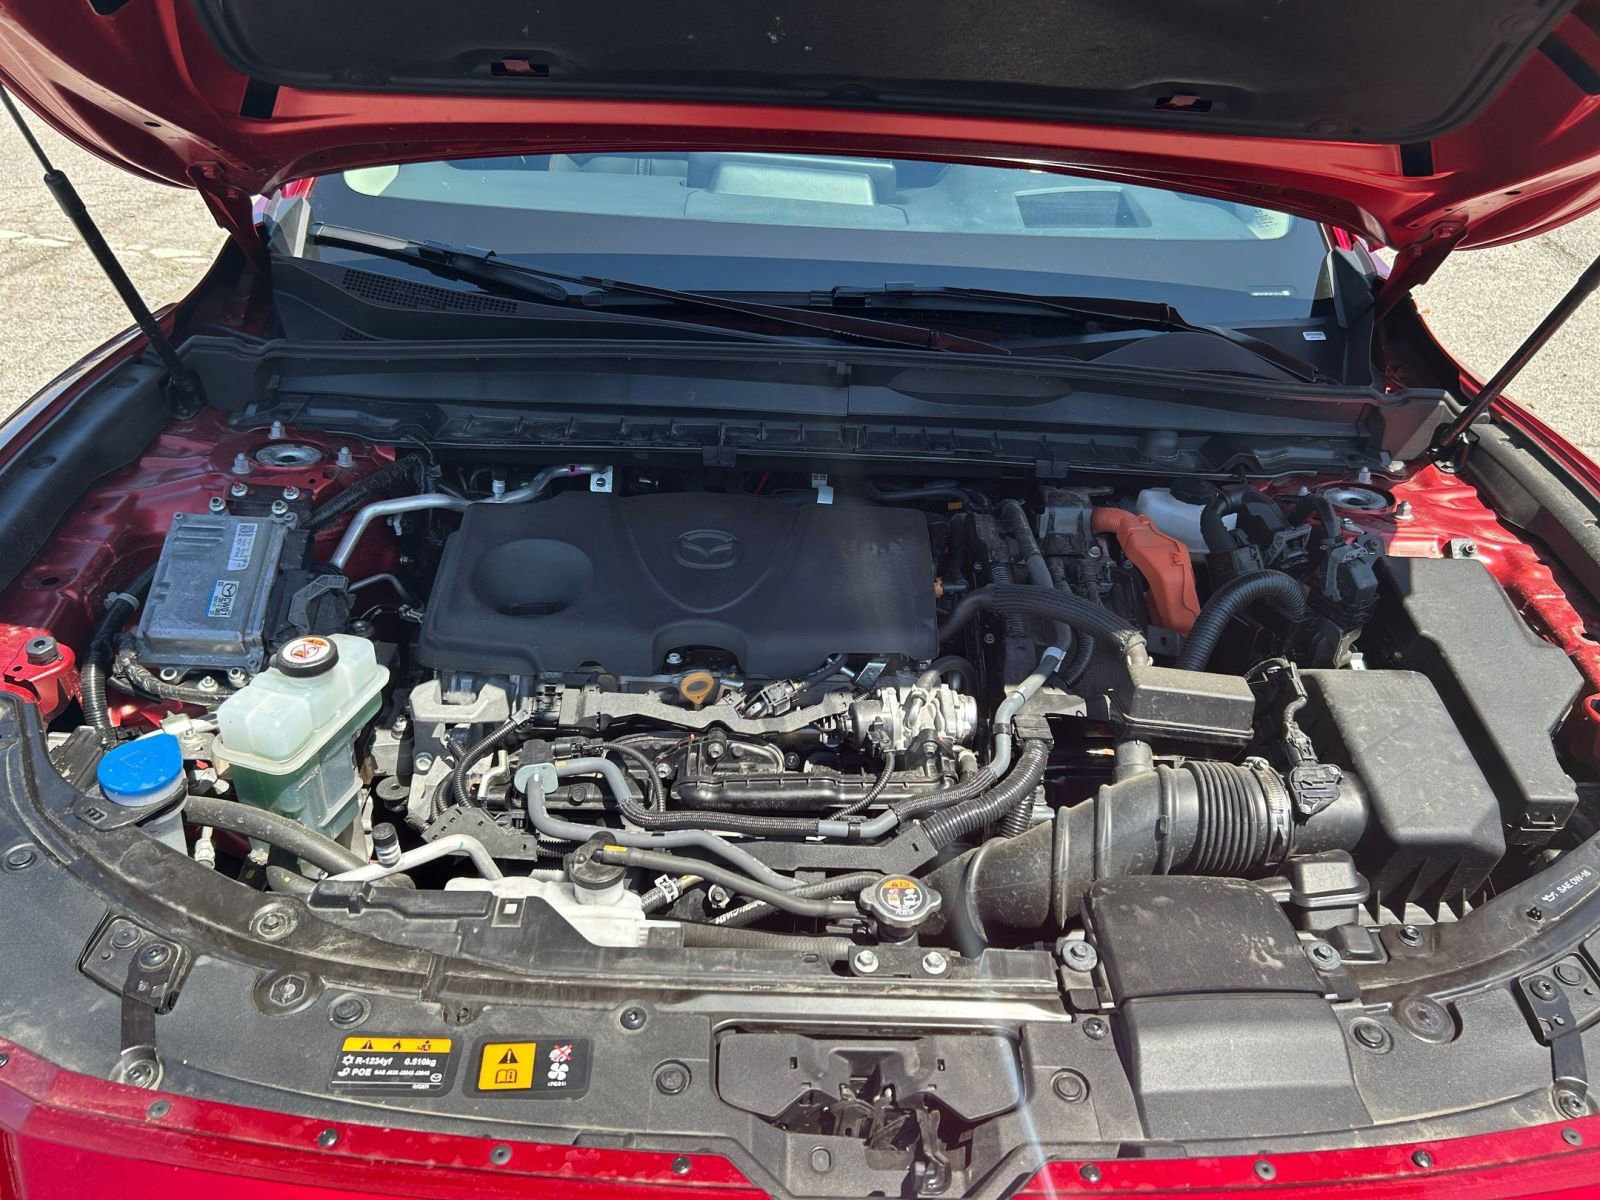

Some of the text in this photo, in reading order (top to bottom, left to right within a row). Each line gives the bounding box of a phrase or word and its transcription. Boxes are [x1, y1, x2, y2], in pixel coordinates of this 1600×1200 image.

[1556, 882, 1573, 893] SAE
[354, 1056, 394, 1066] R-1234yf
[351, 1068, 372, 1076] POE
